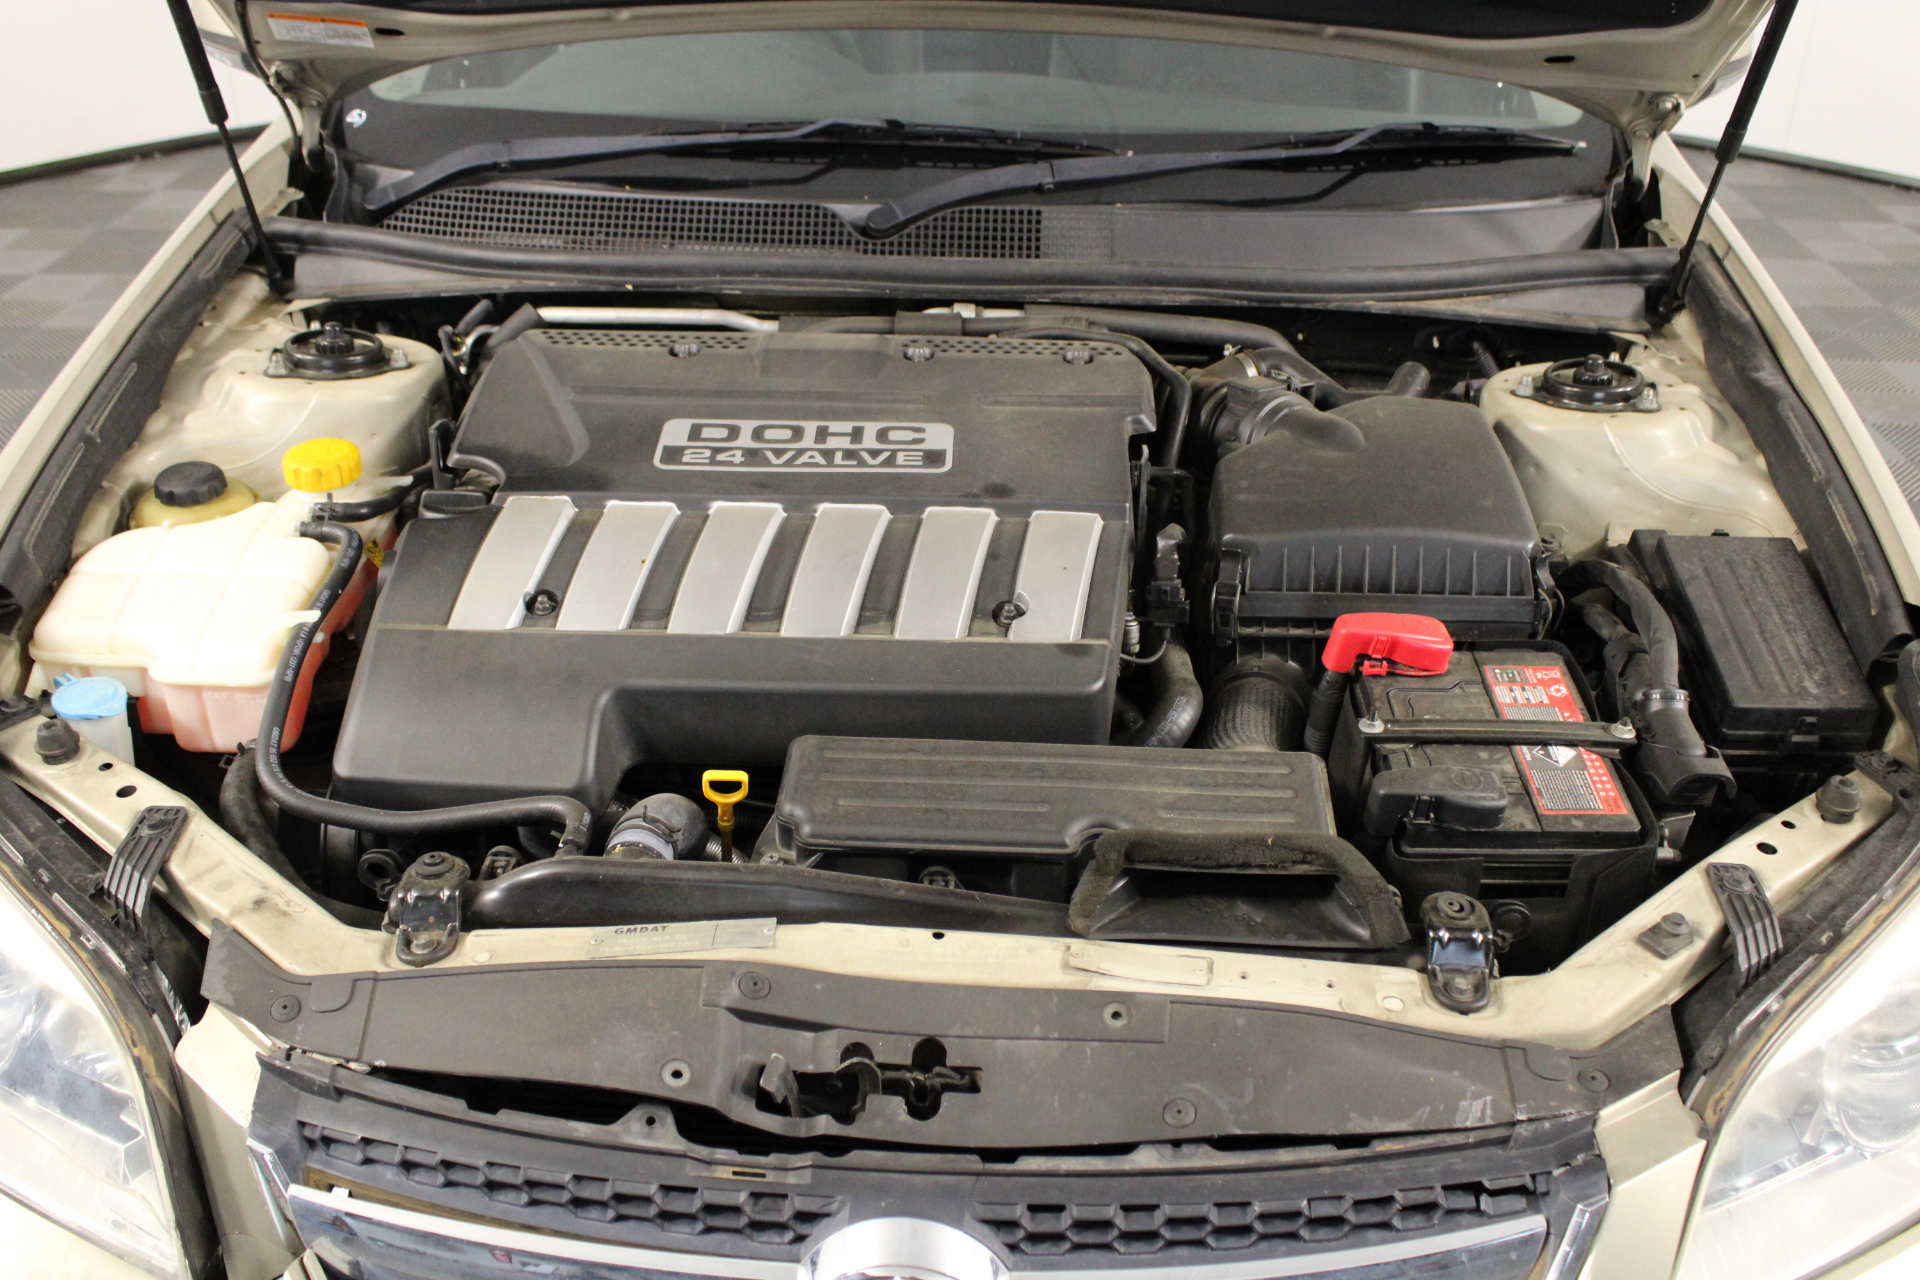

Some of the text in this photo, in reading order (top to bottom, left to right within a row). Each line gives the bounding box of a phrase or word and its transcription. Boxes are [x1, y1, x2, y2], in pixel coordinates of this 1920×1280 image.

[687, 423, 927, 446] DOHC
[681, 448, 924, 466] 24 VALVE
[614, 925, 670, 935] GMDAT
